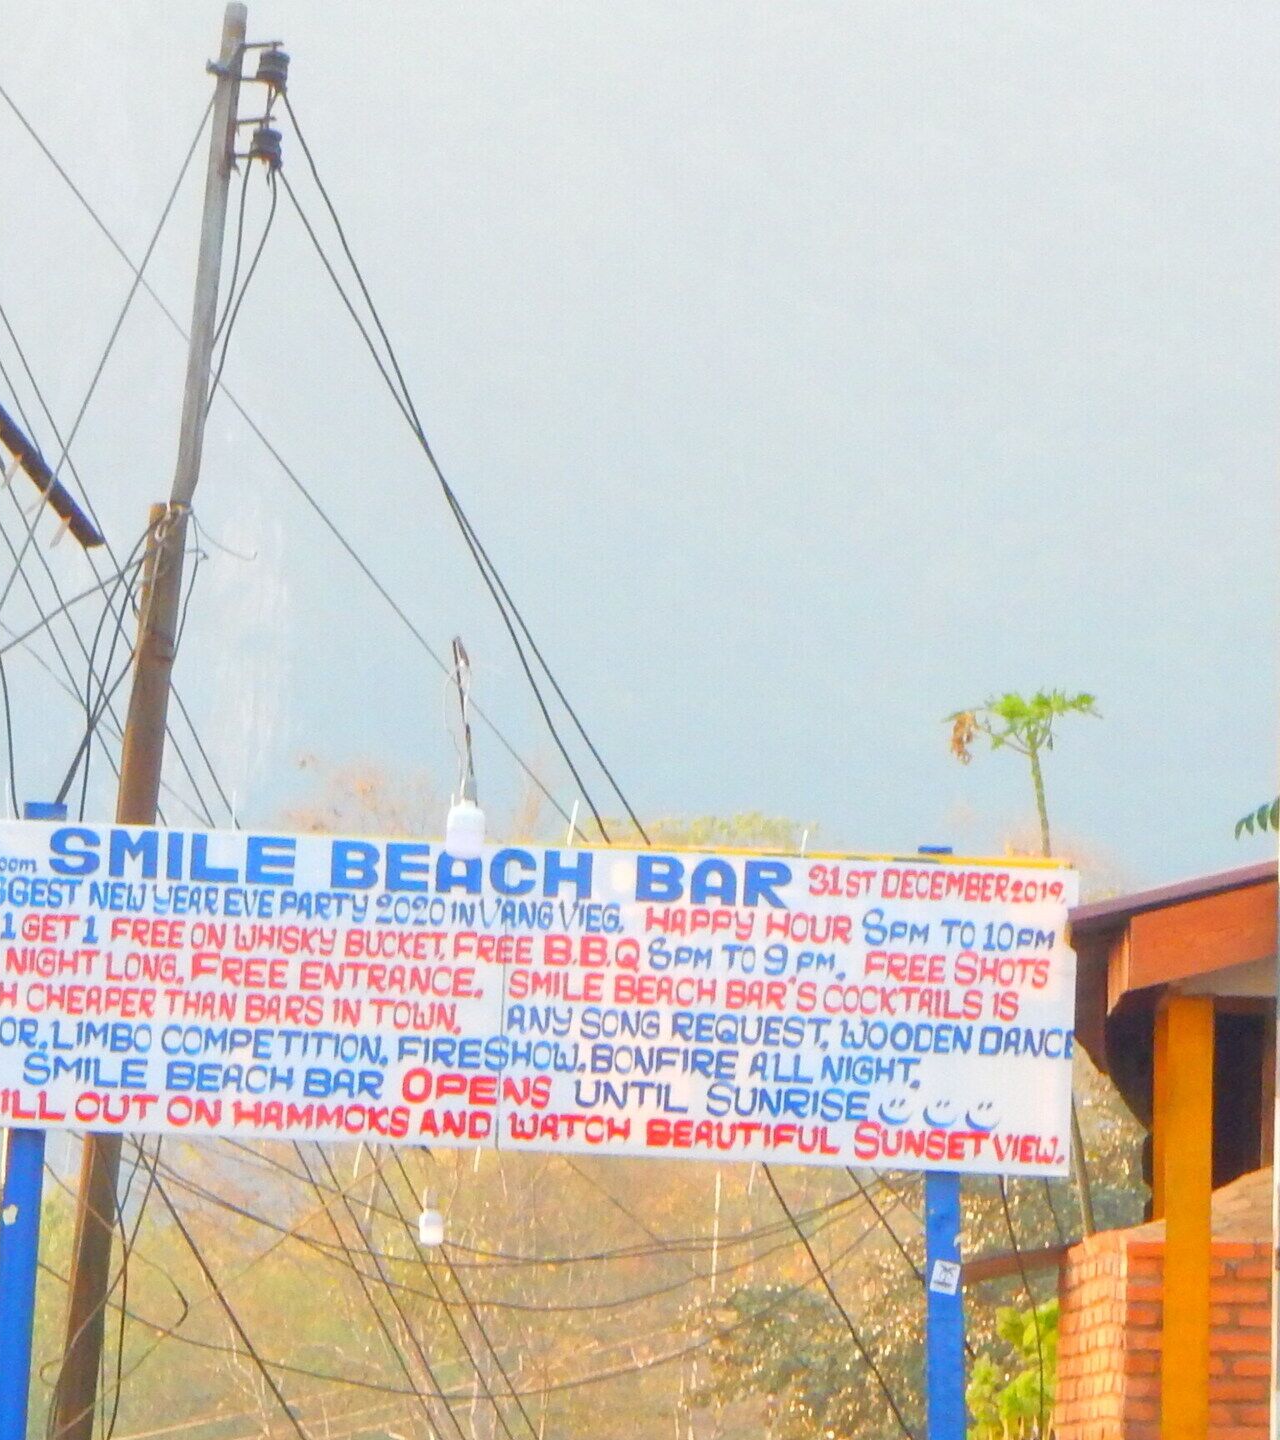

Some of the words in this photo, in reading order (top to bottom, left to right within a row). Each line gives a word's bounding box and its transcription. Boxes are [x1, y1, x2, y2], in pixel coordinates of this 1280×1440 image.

[49, 827, 296, 885] SMILE
[330, 840, 593, 898] BEACH
[635, 855, 793, 909] BAR
[808, 864, 877, 897] 31ST
[881, 868, 1009, 901] DECEMBER
[0, 910, 17, 940] 1
[21, 913, 81, 943] GET
[82, 914, 100, 944] 1
[110, 917, 187, 948] FREE
[191, 921, 226, 951] ON
[234, 922, 337, 957] WHISKY
[453, 930, 534, 965] FREE
[722, 943, 756, 975] TO
[863, 951, 946, 985] FREE
[954, 952, 1051, 990] SHOTS
[89, 881, 147, 913] NEW
[153, 883, 219, 916] YEAR
[223, 887, 275, 919] EVE
[280, 890, 369, 924] PARTY
[376, 893, 446, 926] 2020
[451, 900, 476, 928] IN
[479, 898, 554, 931] VANG
[645, 906, 755, 941] HAPPY
[765, 911, 853, 945] HOUR
[941, 918, 976, 951] TO
[983, 921, 1056, 951] 10PM
[5, 947, 101, 978] NIGHT
[191, 951, 290, 990] FREE
[508, 969, 605, 1001] SMILE
[613, 974, 718, 1008] BEACH
[725, 976, 818, 1012] BAR'S
[822, 984, 983, 1020] COCKTAILS
[992, 990, 1020, 1021] IS
[26, 982, 158, 1019] CHEAPER
[164, 990, 238, 1023] THAN
[244, 993, 324, 1027] BARS
[333, 998, 362, 1027] IN
[507, 1003, 573, 1036] ANY
[580, 1007, 660, 1040] SONG
[840, 1019, 974, 1054] WOODEN
[23, 1051, 148, 1088] SMILE
[166, 1060, 294, 1094] BEACH
[303, 1067, 384, 1099] BAR
[401, 1066, 553, 1110] OPENS
[574, 1079, 689, 1114] UNTIL
[706, 1080, 871, 1122] SUNRISE
[51, 1019, 152, 1053] LIMBO
[590, 1042, 740, 1080] BONFIRE
[749, 1050, 814, 1084] ALL
[74, 1091, 160, 1125] OUT
[166, 1094, 222, 1128] ON
[232, 1099, 410, 1137] HAMMOKS
[419, 1108, 492, 1140] AND
[508, 1110, 631, 1144] WATCH
[646, 1117, 840, 1155] BEAUTIFUL
[853, 1120, 990, 1161] SUNSET
